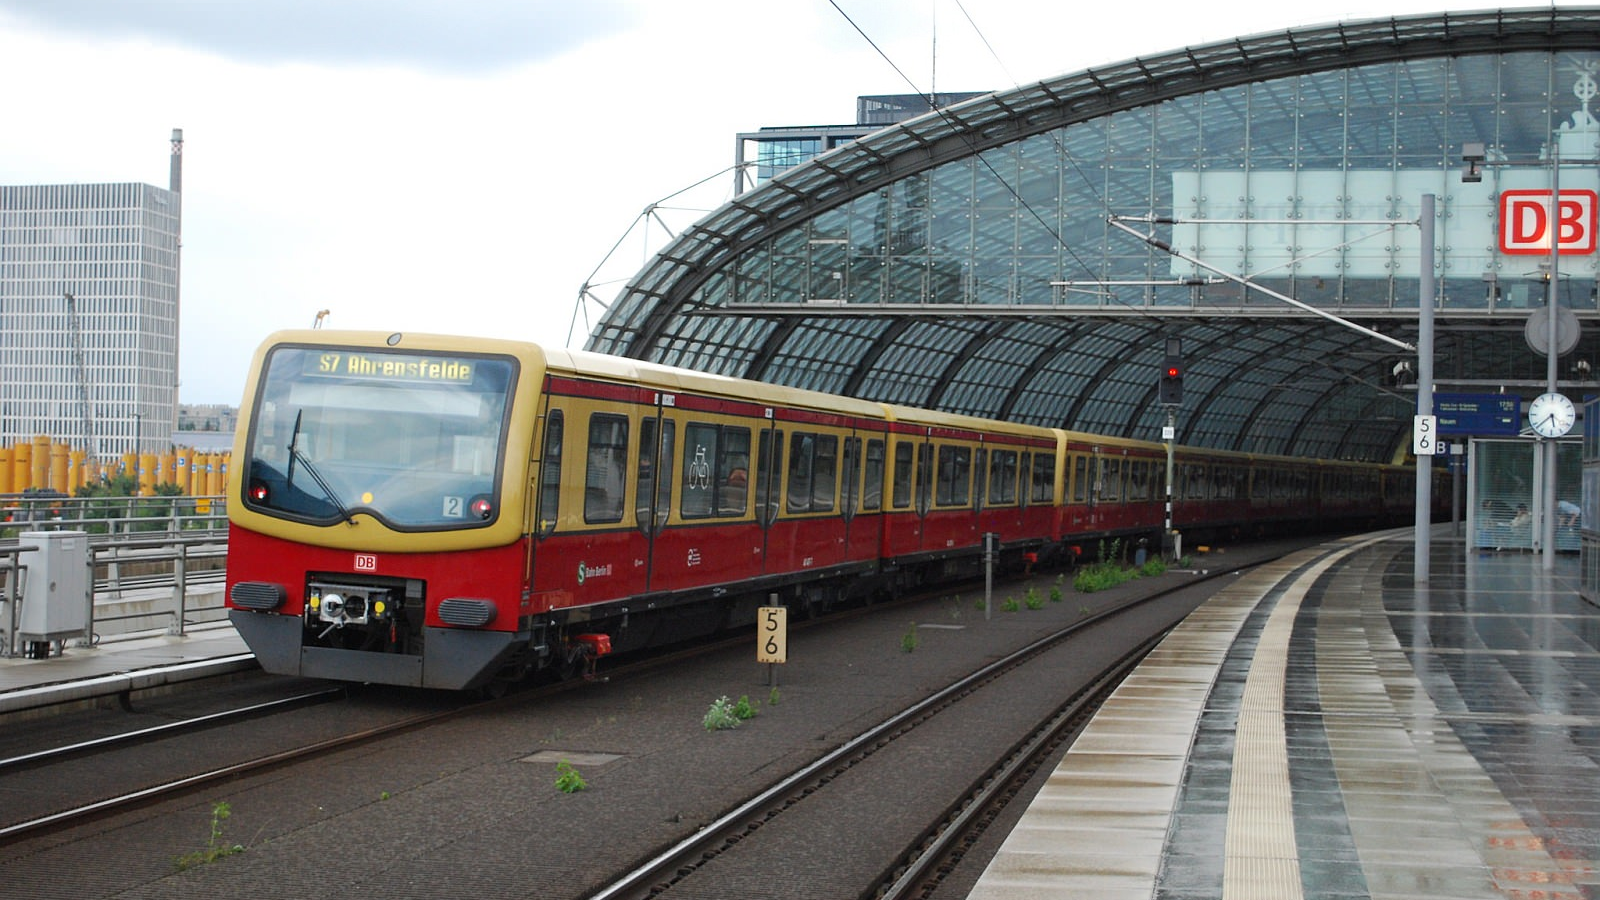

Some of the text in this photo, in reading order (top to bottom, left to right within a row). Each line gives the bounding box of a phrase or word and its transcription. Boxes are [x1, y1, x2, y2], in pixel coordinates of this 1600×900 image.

[1512, 200, 1584, 244] DB
[319, 353, 471, 380] S7 Ahrensfelde
[1420, 418, 1430, 433] 5
[1420, 435, 1430, 449] 6
[1437, 442, 1446, 454] B
[447, 498, 459, 516] 2
[357, 556, 375, 569] DB
[577, 562, 586, 584] S
[765, 612, 778, 632] 5
[765, 635, 778, 655] 6
